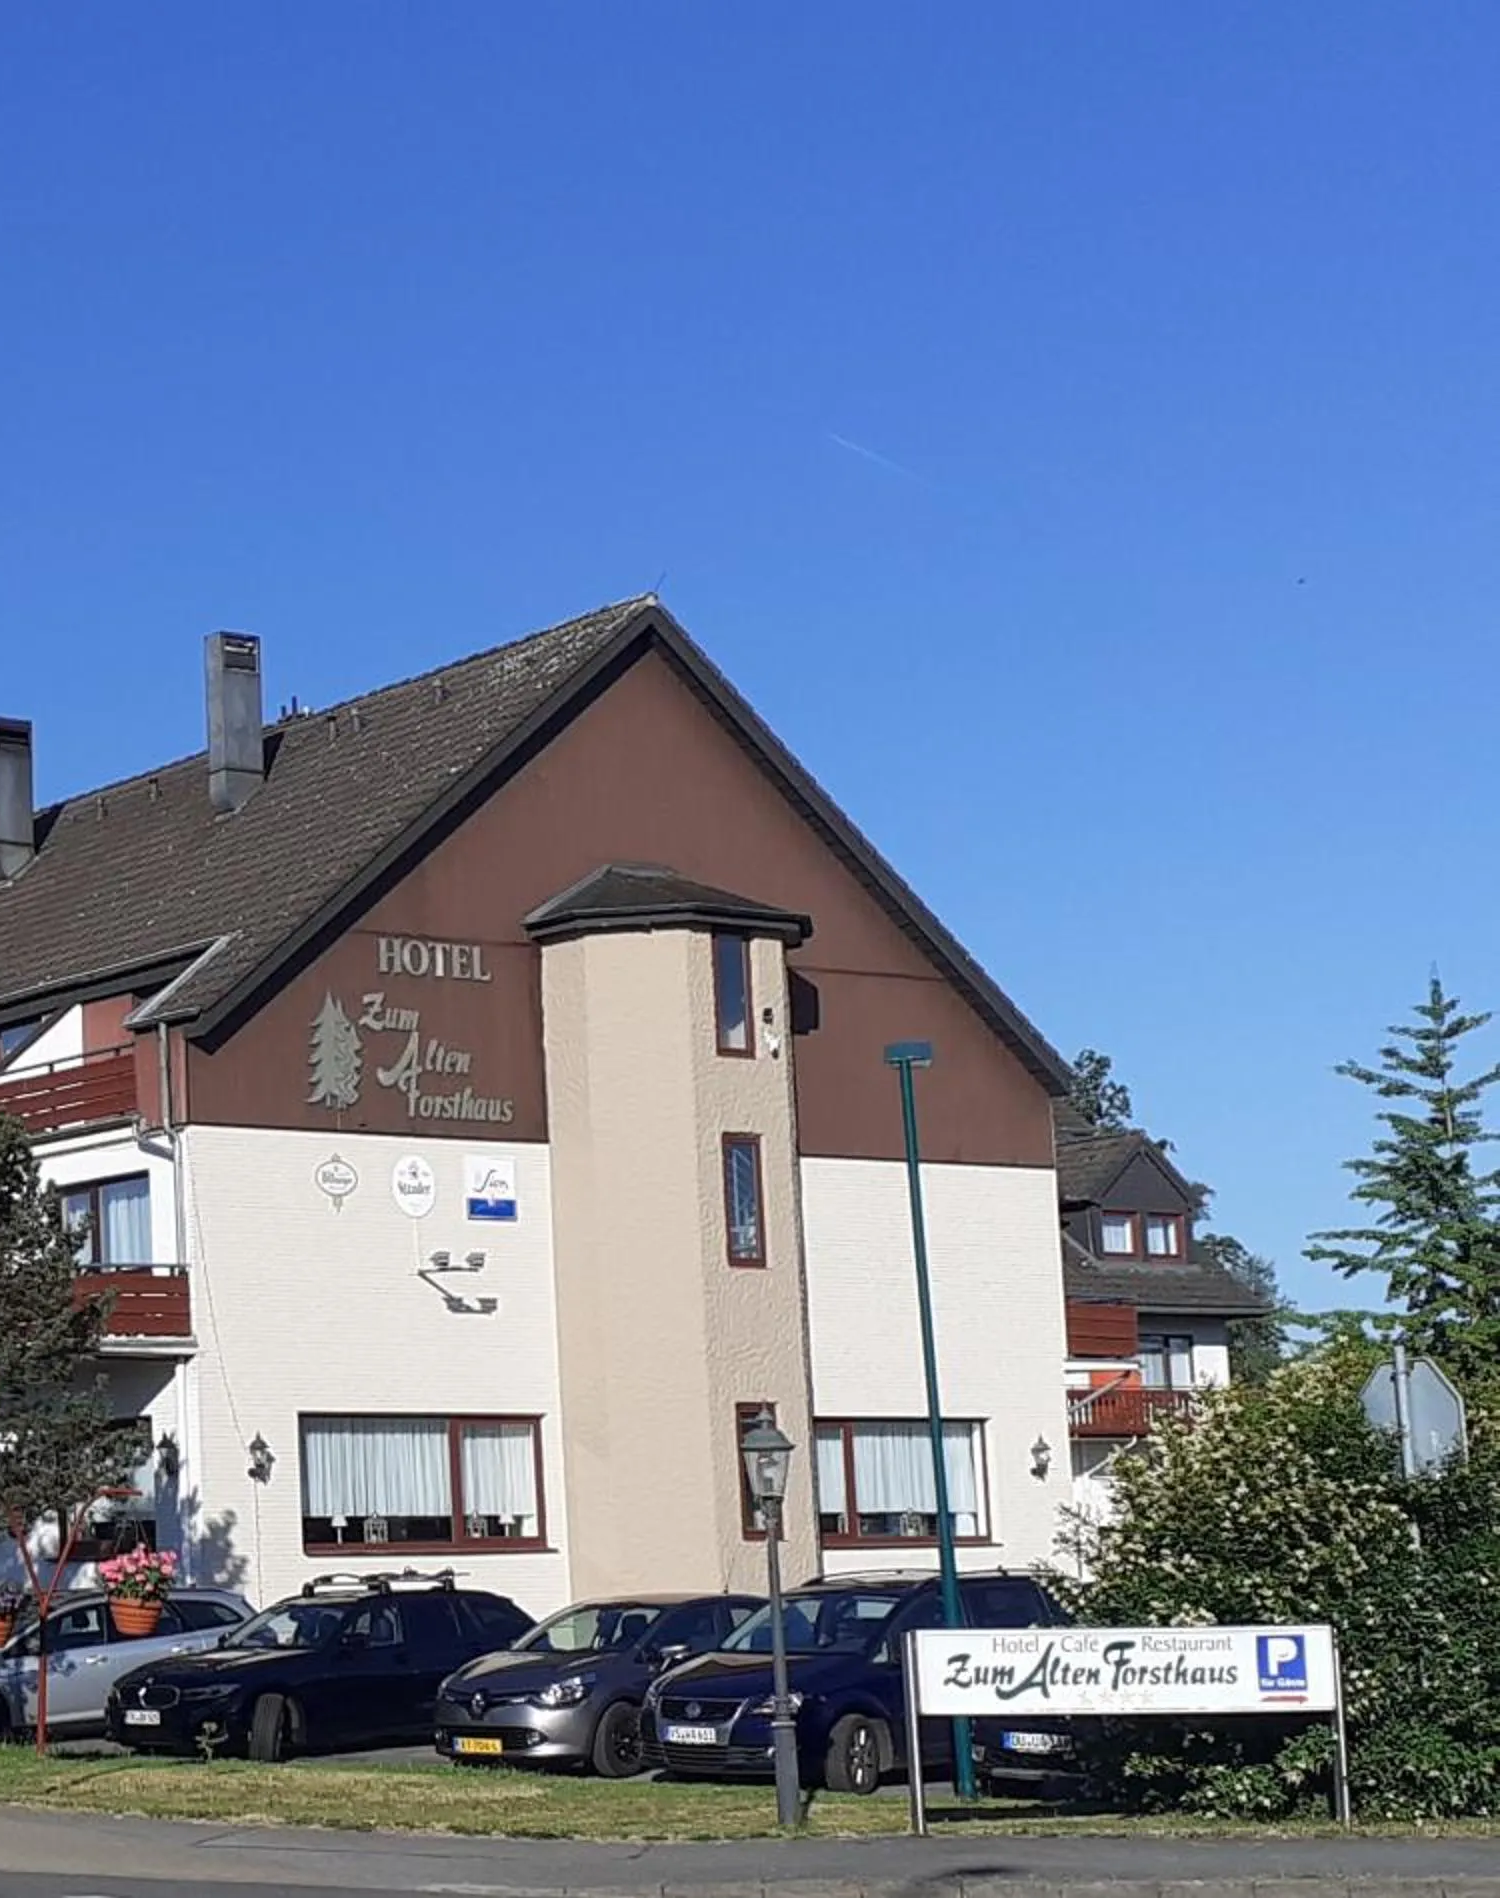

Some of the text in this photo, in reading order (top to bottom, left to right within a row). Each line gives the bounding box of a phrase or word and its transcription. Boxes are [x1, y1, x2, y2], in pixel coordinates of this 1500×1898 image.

[379, 938, 491, 981] HOTEL
[359, 991, 420, 1031] Zum
[377, 1031, 471, 1086] Alten
[992, 1636, 1040, 1653] Hotel
[1141, 1636, 1234, 1651] Restaurant
[1267, 1637, 1298, 1676] P
[943, 1640, 1238, 1700] Zum Alten Forsthaus
